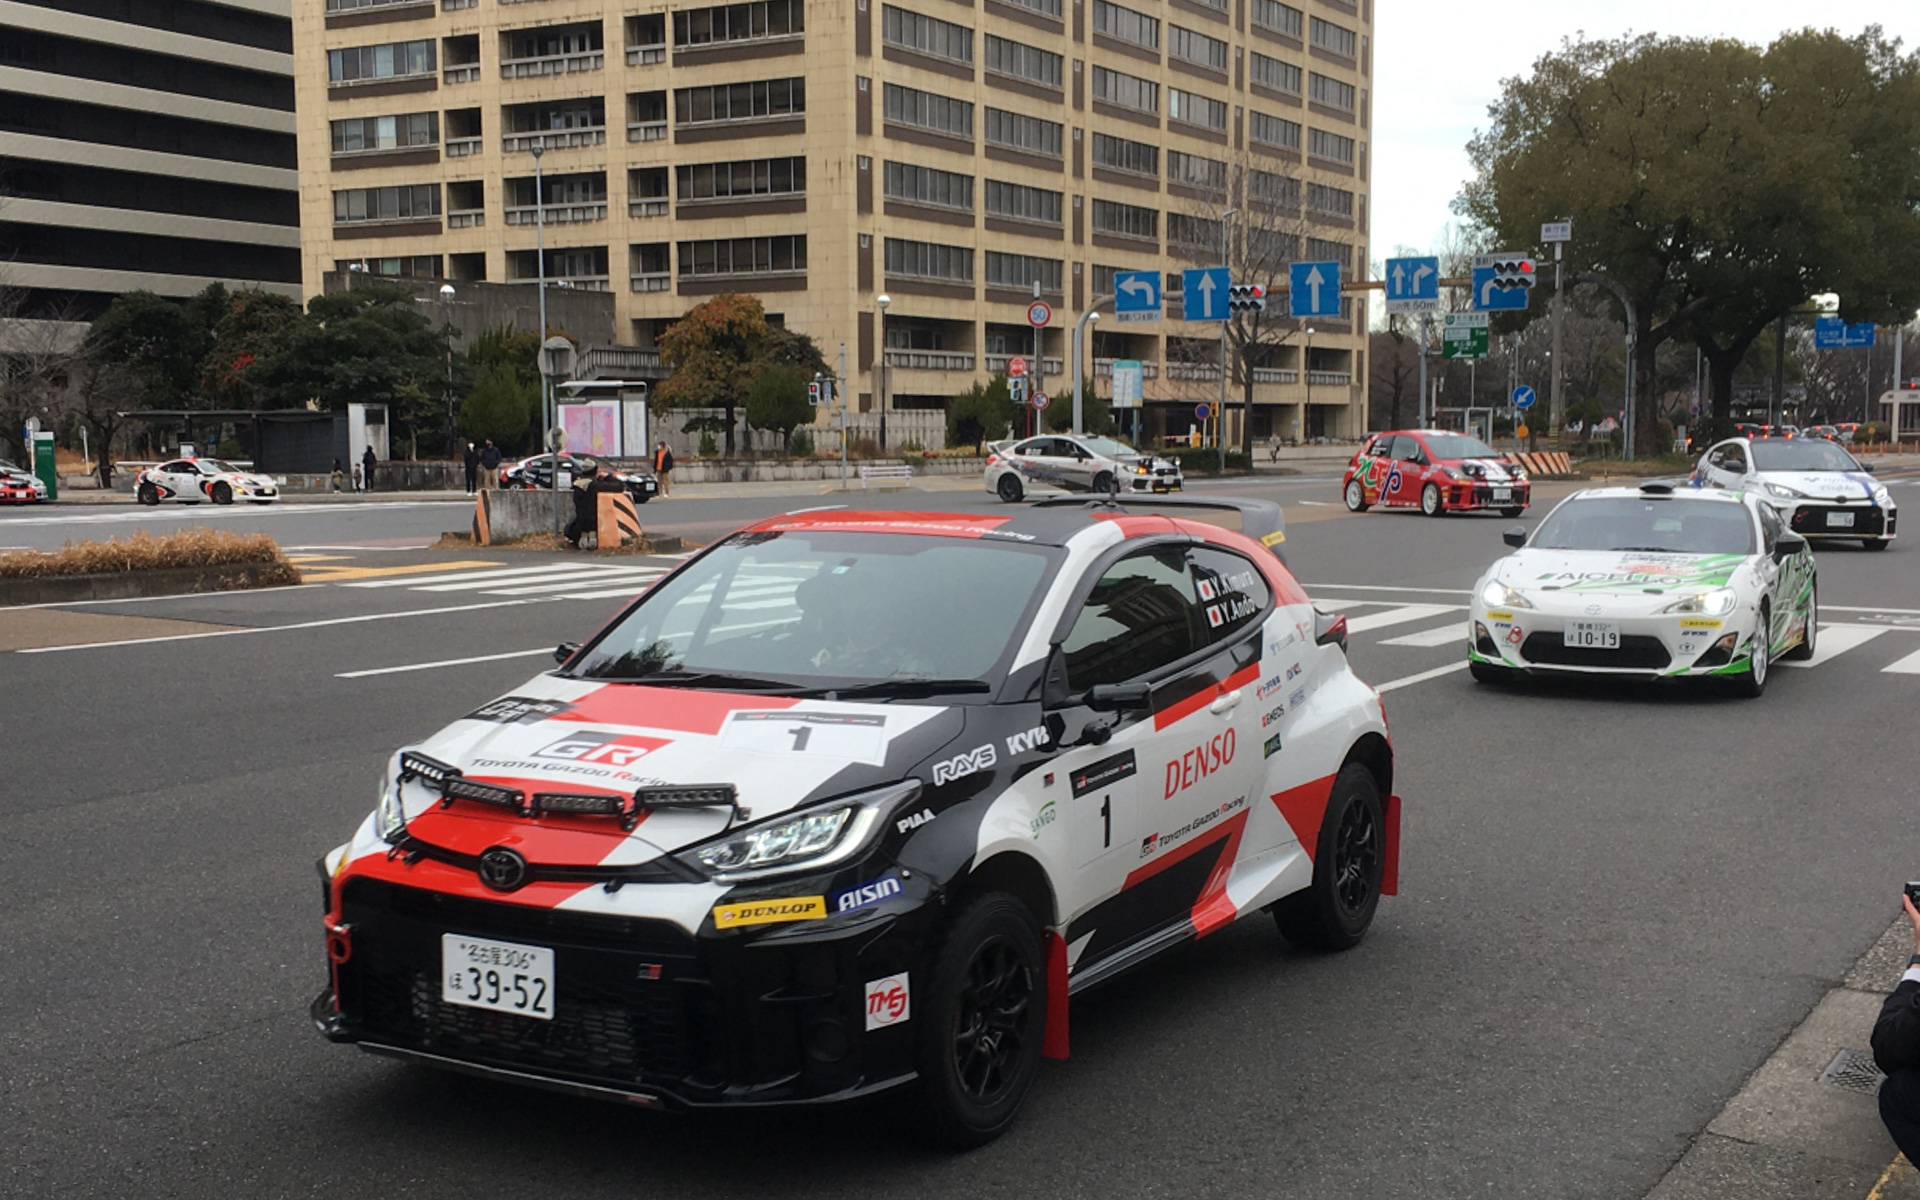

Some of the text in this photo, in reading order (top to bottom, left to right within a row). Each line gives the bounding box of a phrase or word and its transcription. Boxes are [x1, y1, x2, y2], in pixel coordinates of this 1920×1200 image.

[1031, 309, 1046, 320] 50
[1413, 300, 1436, 311] 50m
[1576, 632, 1618, 646] 10-19
[788, 726, 812, 751] 1
[1005, 725, 1050, 755] KYB
[536, 741, 650, 767] GR
[932, 743, 997, 787] RAYS
[1164, 727, 1236, 800] DENSO
[470, 758, 537, 769] TOYOTA
[542, 763, 611, 777] GAZOO
[897, 808, 936, 834] PIAA
[1030, 809, 1056, 832] SANGO
[1100, 794, 1111, 848] 1
[1158, 824, 1191, 847] TOYOTA
[1192, 809, 1220, 830] GAZOO
[1220, 795, 1245, 815] Racing
[837, 878, 900, 912] AISIN
[738, 902, 816, 919] DUNLOP
[467, 967, 547, 1013] 39-52
